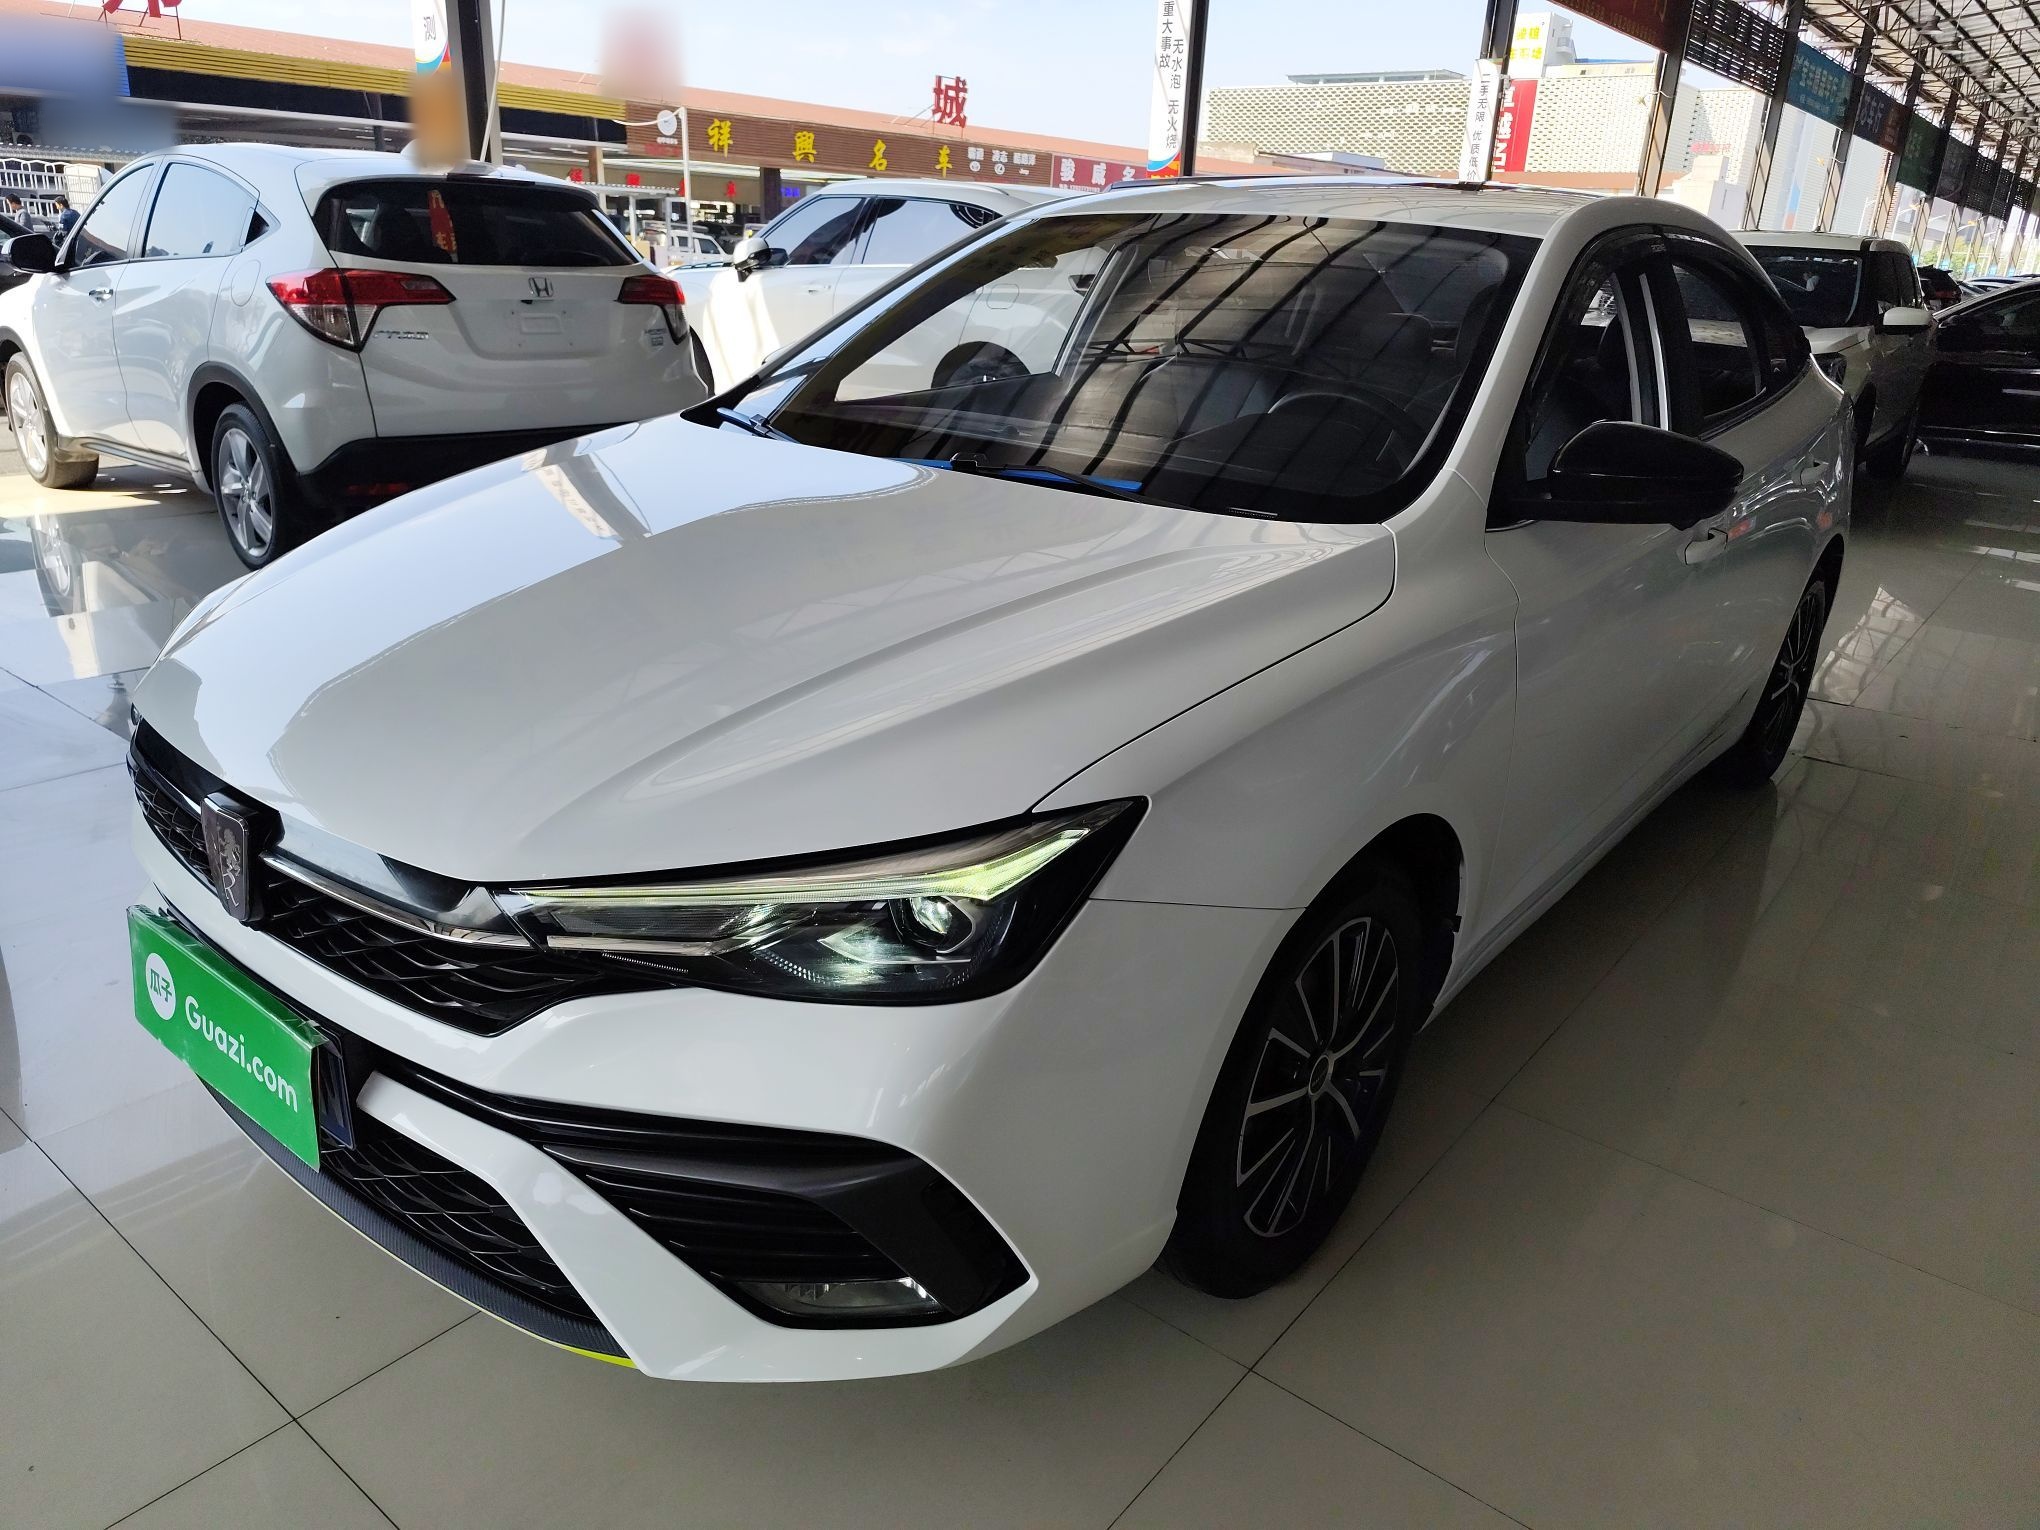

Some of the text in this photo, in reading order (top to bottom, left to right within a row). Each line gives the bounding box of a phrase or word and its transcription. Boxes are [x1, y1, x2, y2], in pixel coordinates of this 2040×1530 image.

[931, 75, 968, 128] 城
[1166, 39, 1184, 149] 无水泡 无火烧
[149, 967, 173, 1003] 瓜子
[184, 995, 299, 1113] Guazi.com
